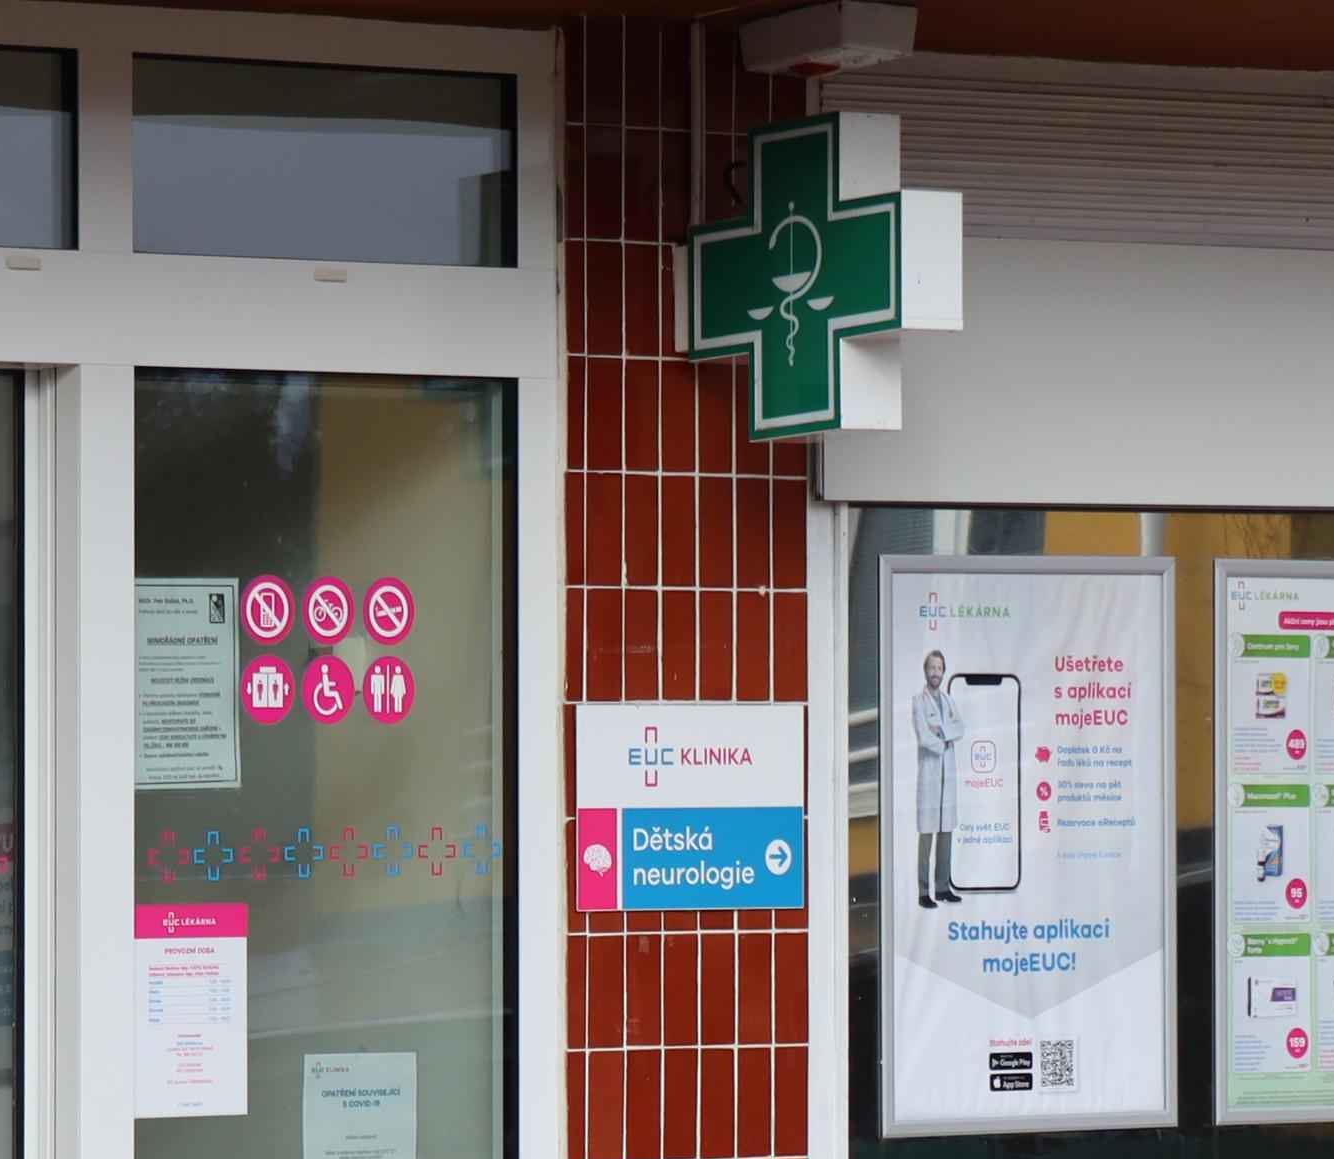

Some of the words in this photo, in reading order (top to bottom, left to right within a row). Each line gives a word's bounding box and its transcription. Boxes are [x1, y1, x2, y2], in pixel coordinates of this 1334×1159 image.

[1231, 591, 1252, 600] EUC
[1254, 589, 1299, 601] LÉKÁRNA
[919, 606, 946, 618] EUC
[950, 603, 1010, 618] LÉKÁRNA
[1054, 655, 1124, 673] Ušetřete
[1054, 687, 1063, 699] s
[1067, 682, 1132, 702] aplikací
[1055, 709, 1129, 730] mojeEUC
[628, 748, 674, 765] EUC
[680, 747, 753, 766] KLINIKA
[1107, 759, 1132, 768] recept
[964, 778, 1004, 790] mojeEUC
[994, 823, 1010, 831] EUC
[632, 826, 713, 852] Dětská
[633, 860, 755, 890] neurologie
[1290, 888, 1303, 898] 95
[181, 917, 217, 926] LÉKÁRNA
[948, 920, 1028, 944] Stahujte
[1032, 918, 1110, 944] aplikaci
[164, 947, 196, 955] PROVOZNÍ
[982, 952, 1076, 976] mojeEUC!
[1289, 1037, 1305, 1048] 159
[1000, 1059, 1019, 1068] Google
[321, 1088, 356, 1098] OPATŘENÍ
[348, 1100, 380, 1108] COVID-19
